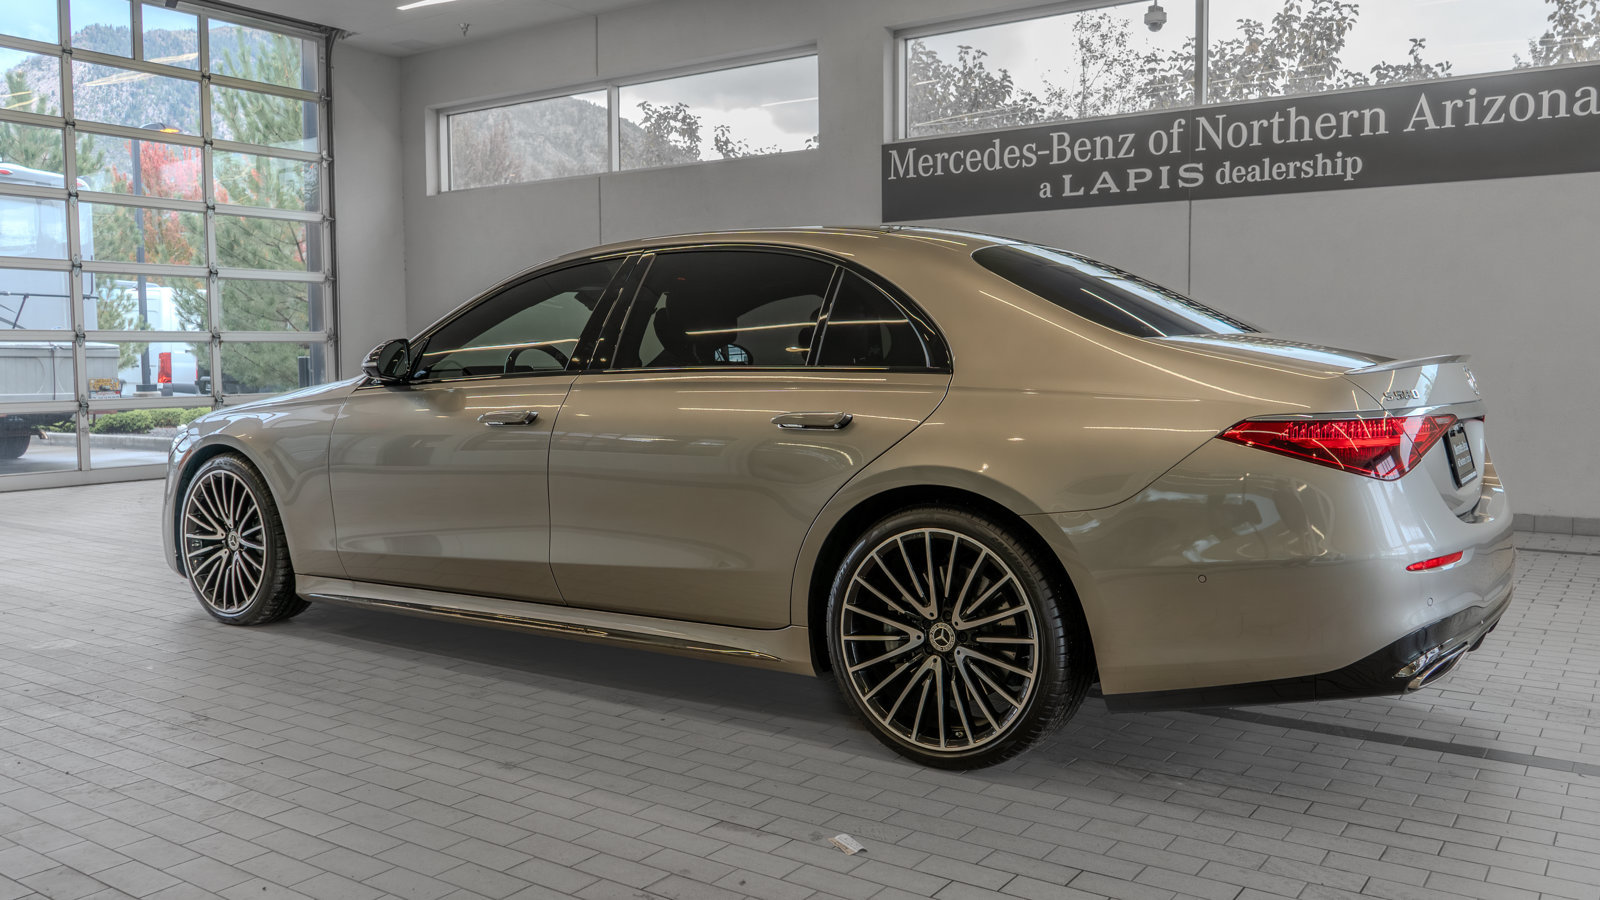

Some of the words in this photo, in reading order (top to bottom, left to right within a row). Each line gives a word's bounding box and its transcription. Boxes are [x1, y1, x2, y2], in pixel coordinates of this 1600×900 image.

[888, 131, 1135, 180] Mercedes-Benz
[1148, 117, 1186, 156] of
[1194, 106, 1390, 152] Northern
[1402, 84, 1600, 133] Arizona
[1039, 182, 1053, 199] a
[1062, 162, 1205, 197] LAPIS
[1215, 151, 1363, 185] dealership
